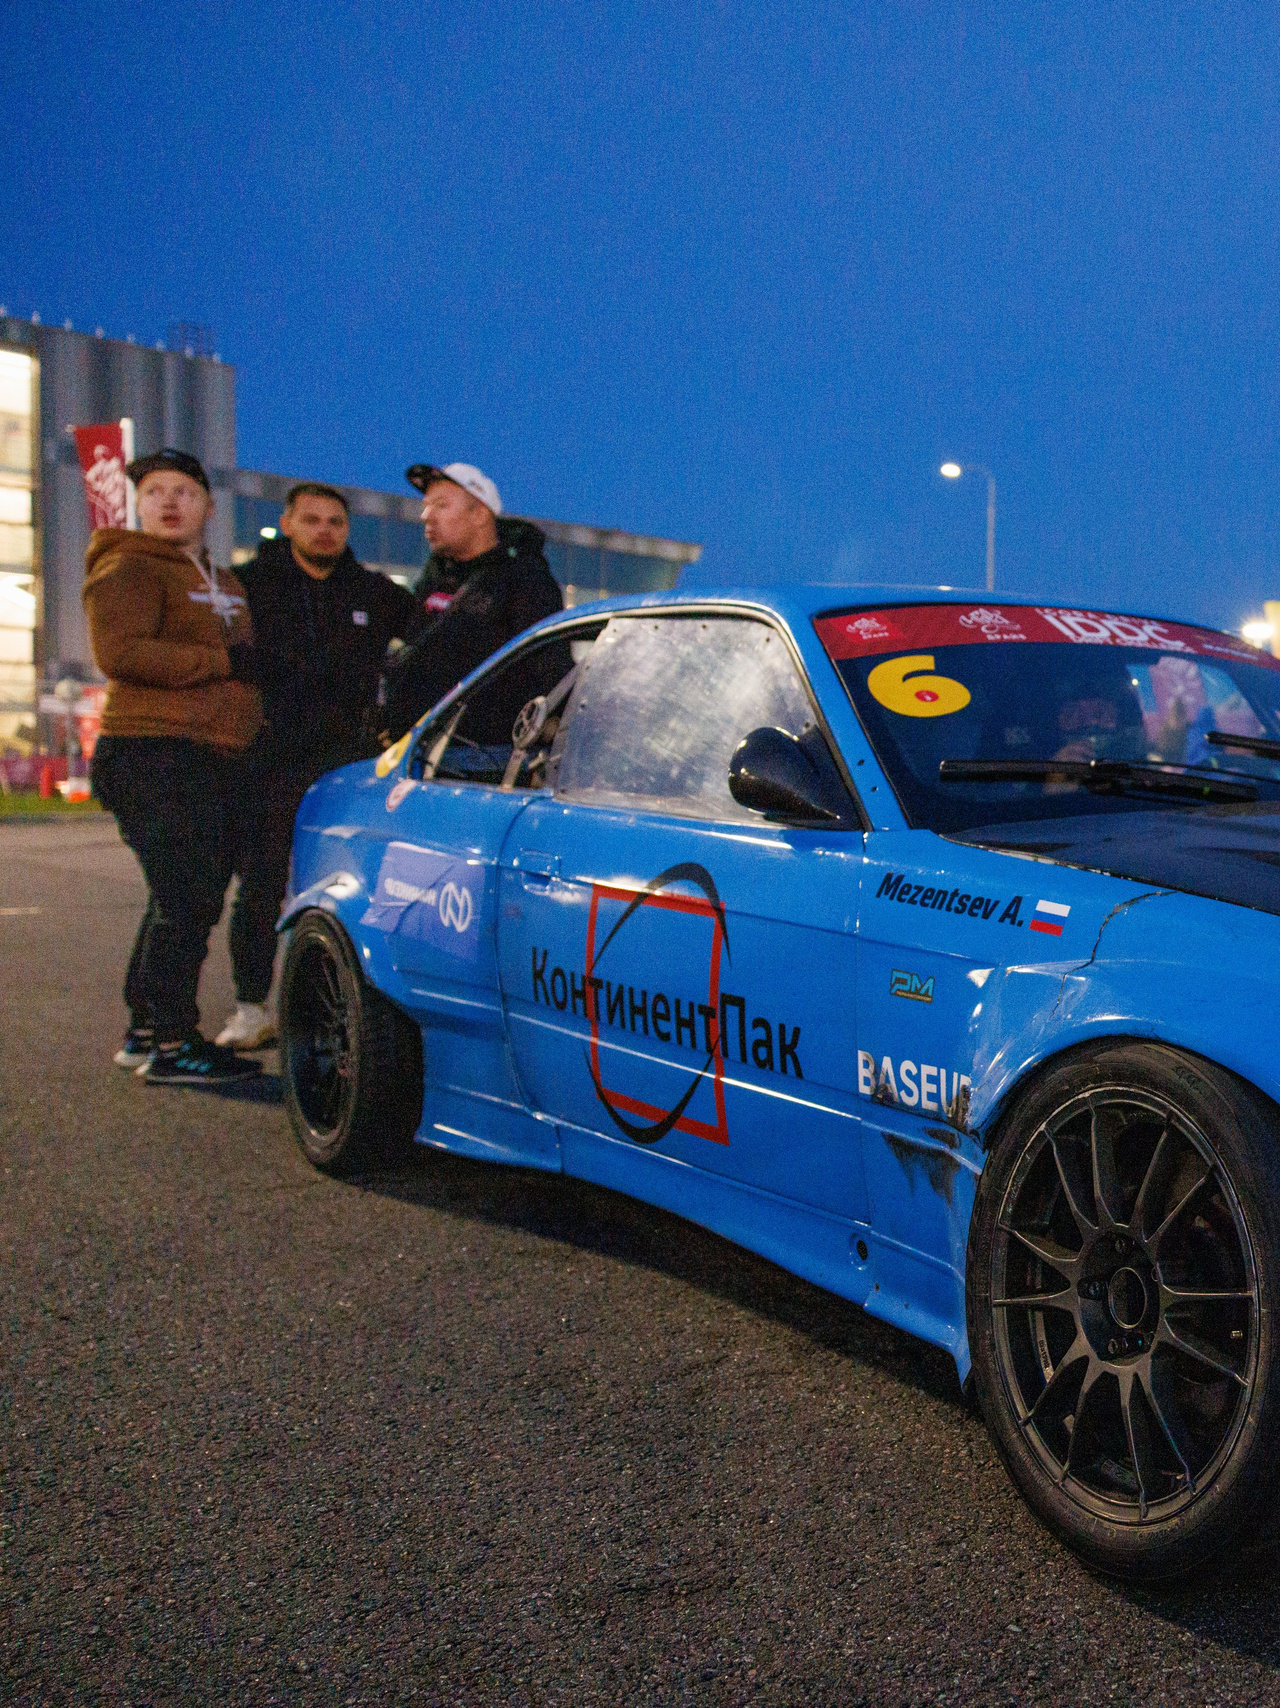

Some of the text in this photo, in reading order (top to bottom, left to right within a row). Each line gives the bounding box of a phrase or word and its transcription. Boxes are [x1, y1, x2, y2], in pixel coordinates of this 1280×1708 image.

[1043, 613, 1186, 648] IDDC
[867, 655, 971, 717] 6
[876, 872, 1023, 927] Mezentsev A.
[532, 946, 804, 1080] КонтинентПак
